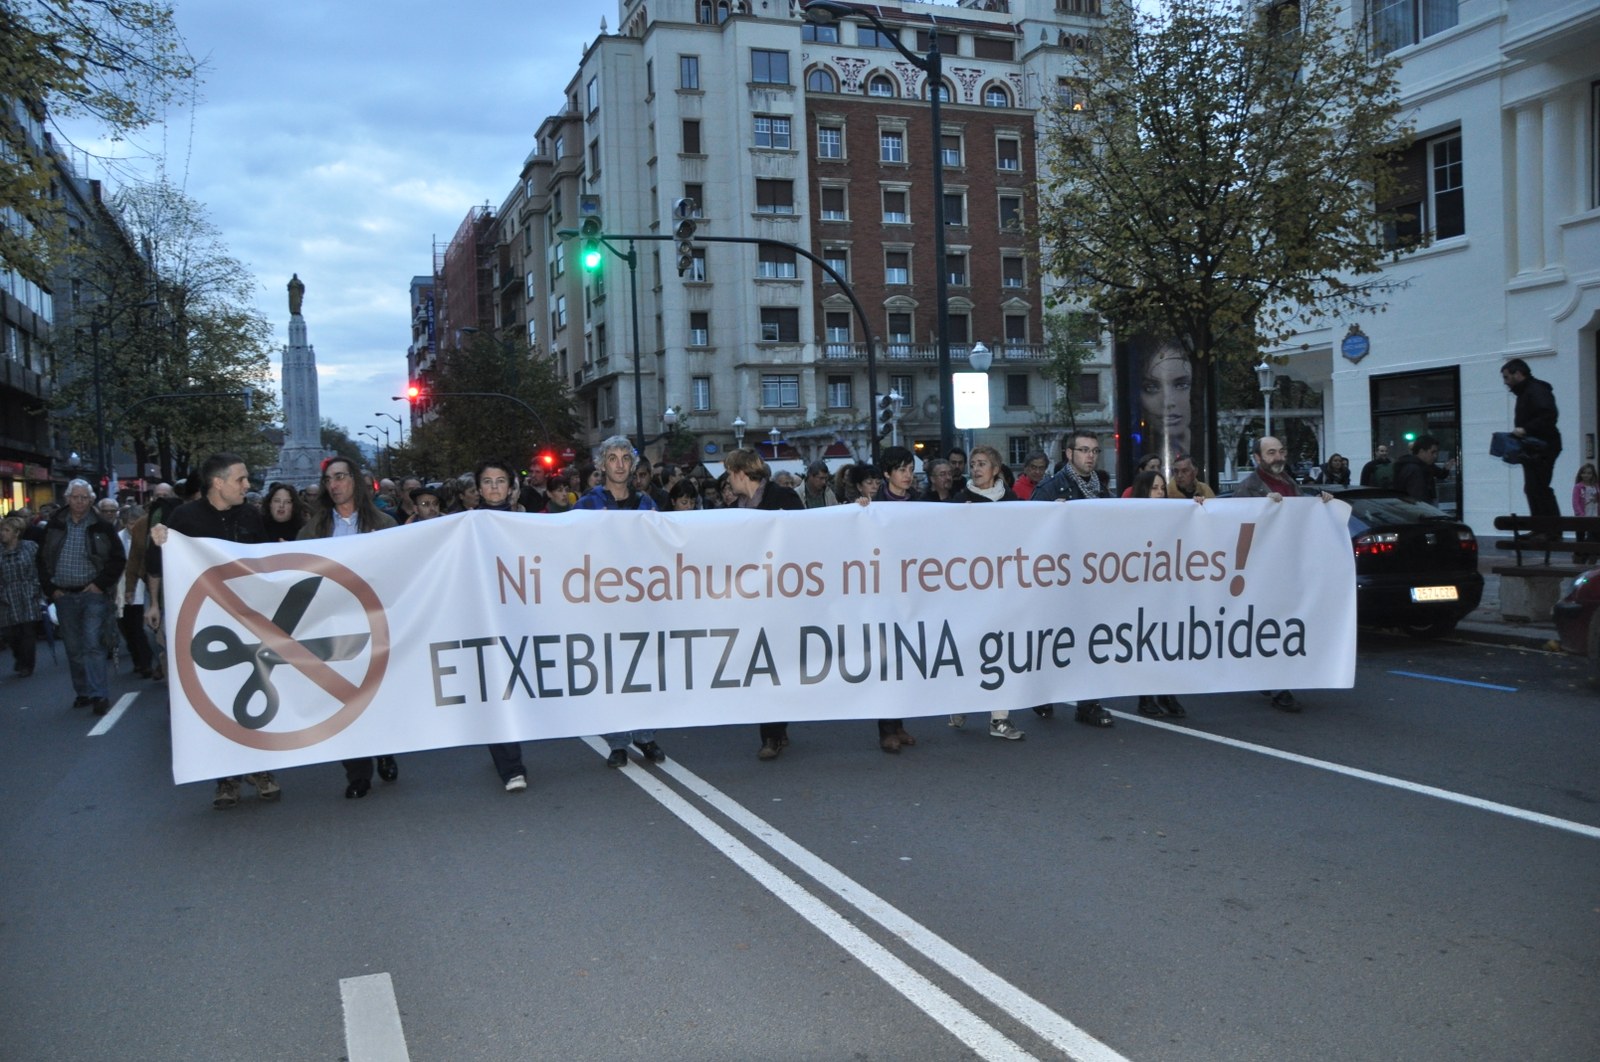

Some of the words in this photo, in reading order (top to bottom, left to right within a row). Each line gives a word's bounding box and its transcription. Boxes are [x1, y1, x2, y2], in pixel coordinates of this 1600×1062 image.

[496, 555, 541, 605] Ni
[562, 551, 824, 603] desahucios
[843, 548, 880, 595] ni
[901, 547, 1071, 593] recortes
[1082, 523, 1256, 597] sociales!
[430, 626, 781, 707] ETXEBIZITZA
[800, 619, 964, 685] DUINA
[979, 624, 1076, 690] gure
[1088, 604, 1307, 664] eskubidea
